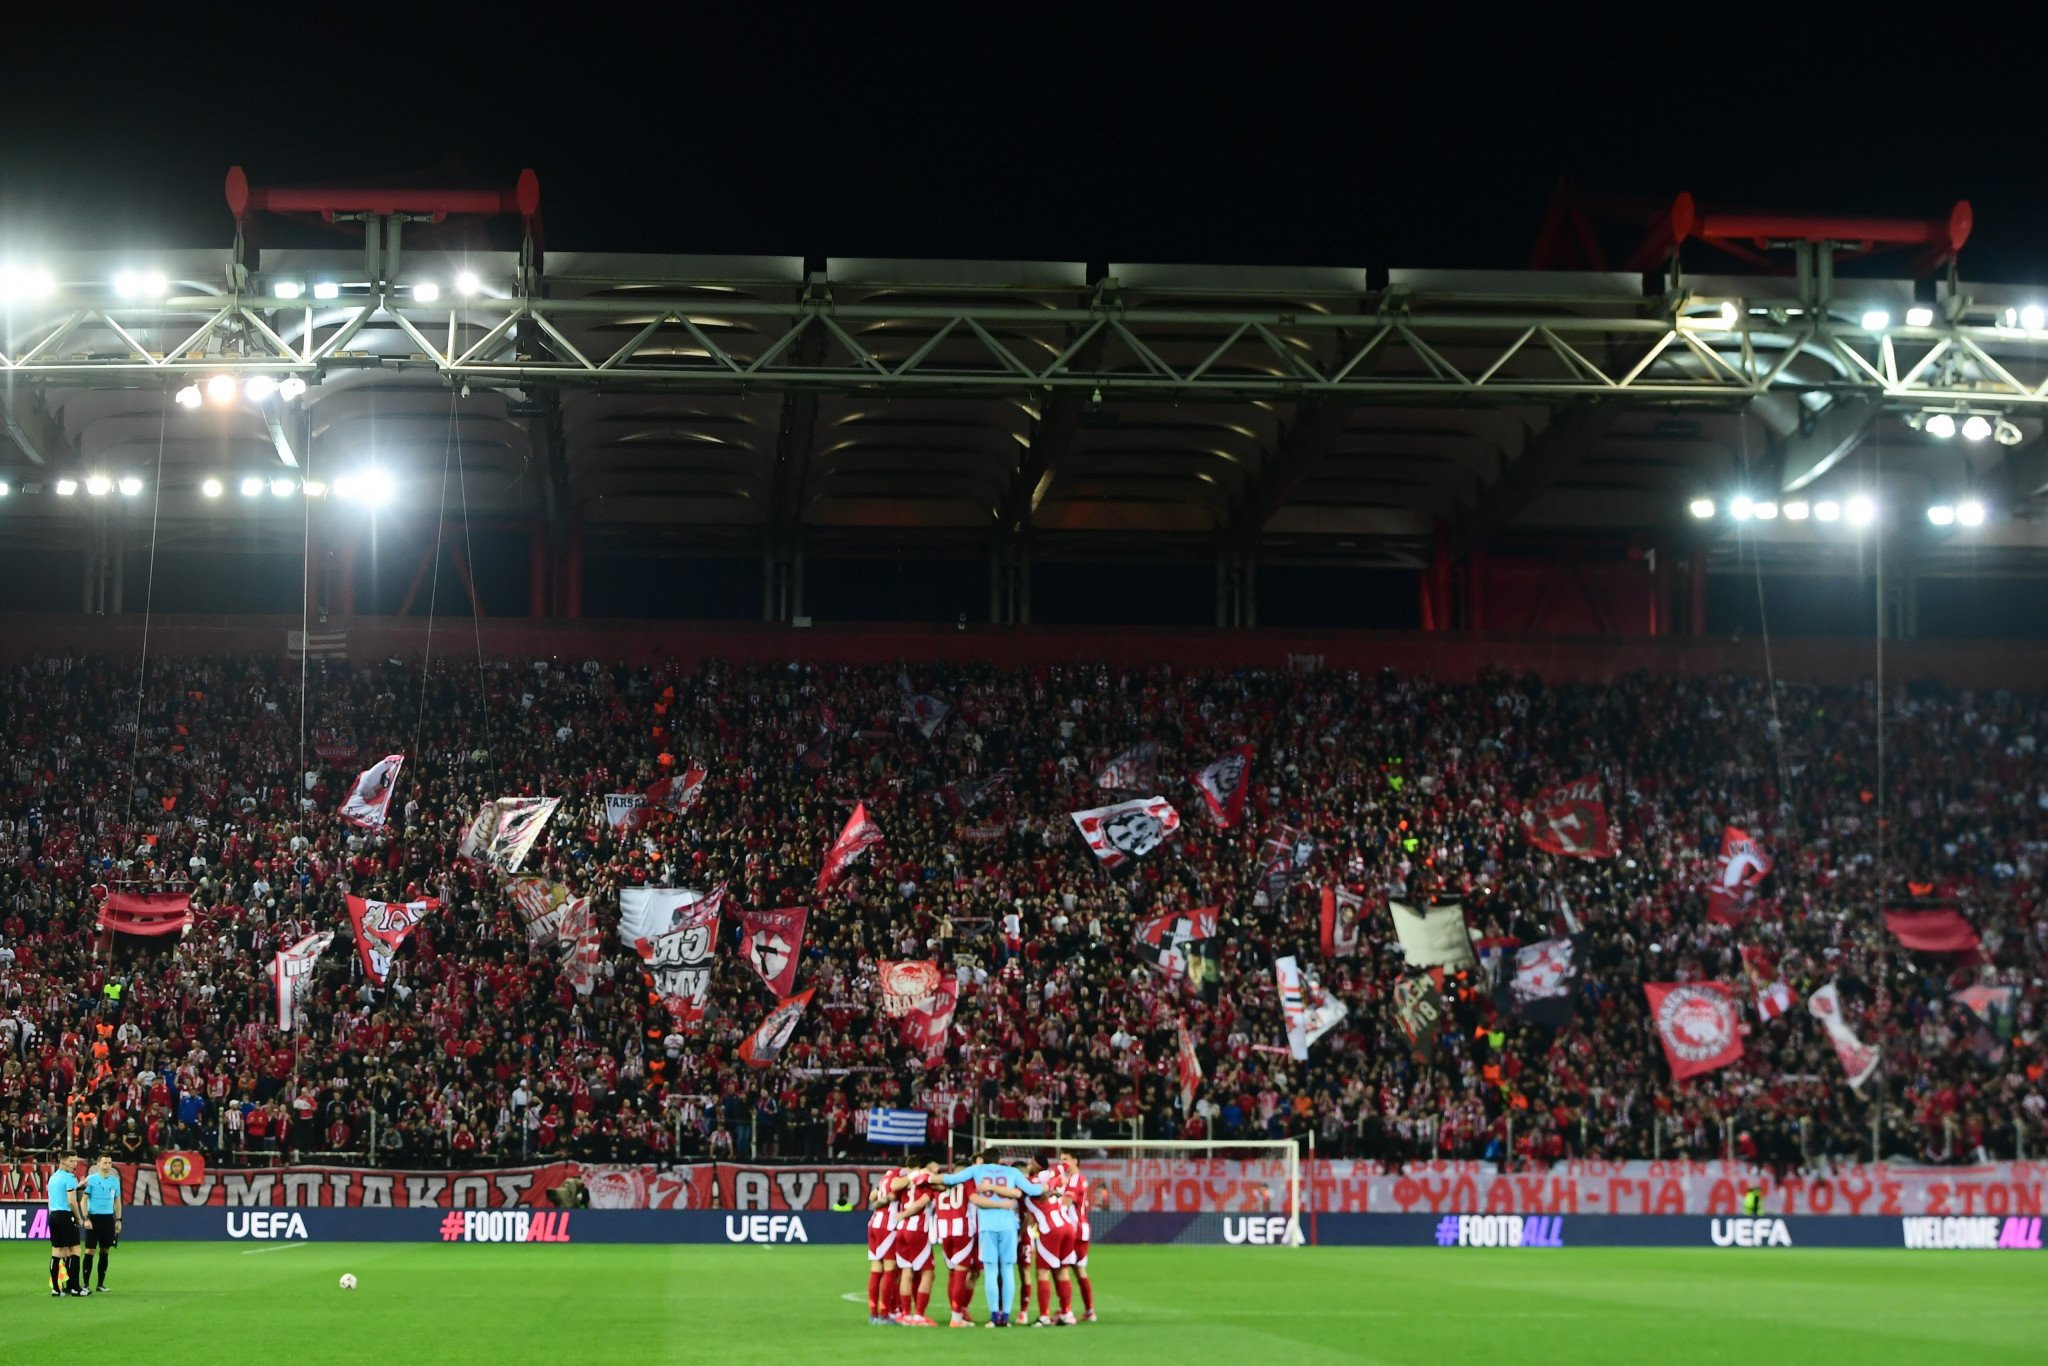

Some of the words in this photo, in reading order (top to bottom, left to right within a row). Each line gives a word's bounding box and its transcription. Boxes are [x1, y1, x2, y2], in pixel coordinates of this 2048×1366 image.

[737, 1171, 881, 1211] ΑΥΡ
[938, 1182, 964, 1210] 20
[227, 1212, 308, 1239] UEFA
[440, 1211, 571, 1242] #FOOTBALL
[726, 1215, 808, 1243] UEFA
[1223, 1216, 1305, 1244] UEFA
[1435, 1215, 1563, 1247] #FOOTBALL
[1710, 1218, 1792, 1247] UEFA
